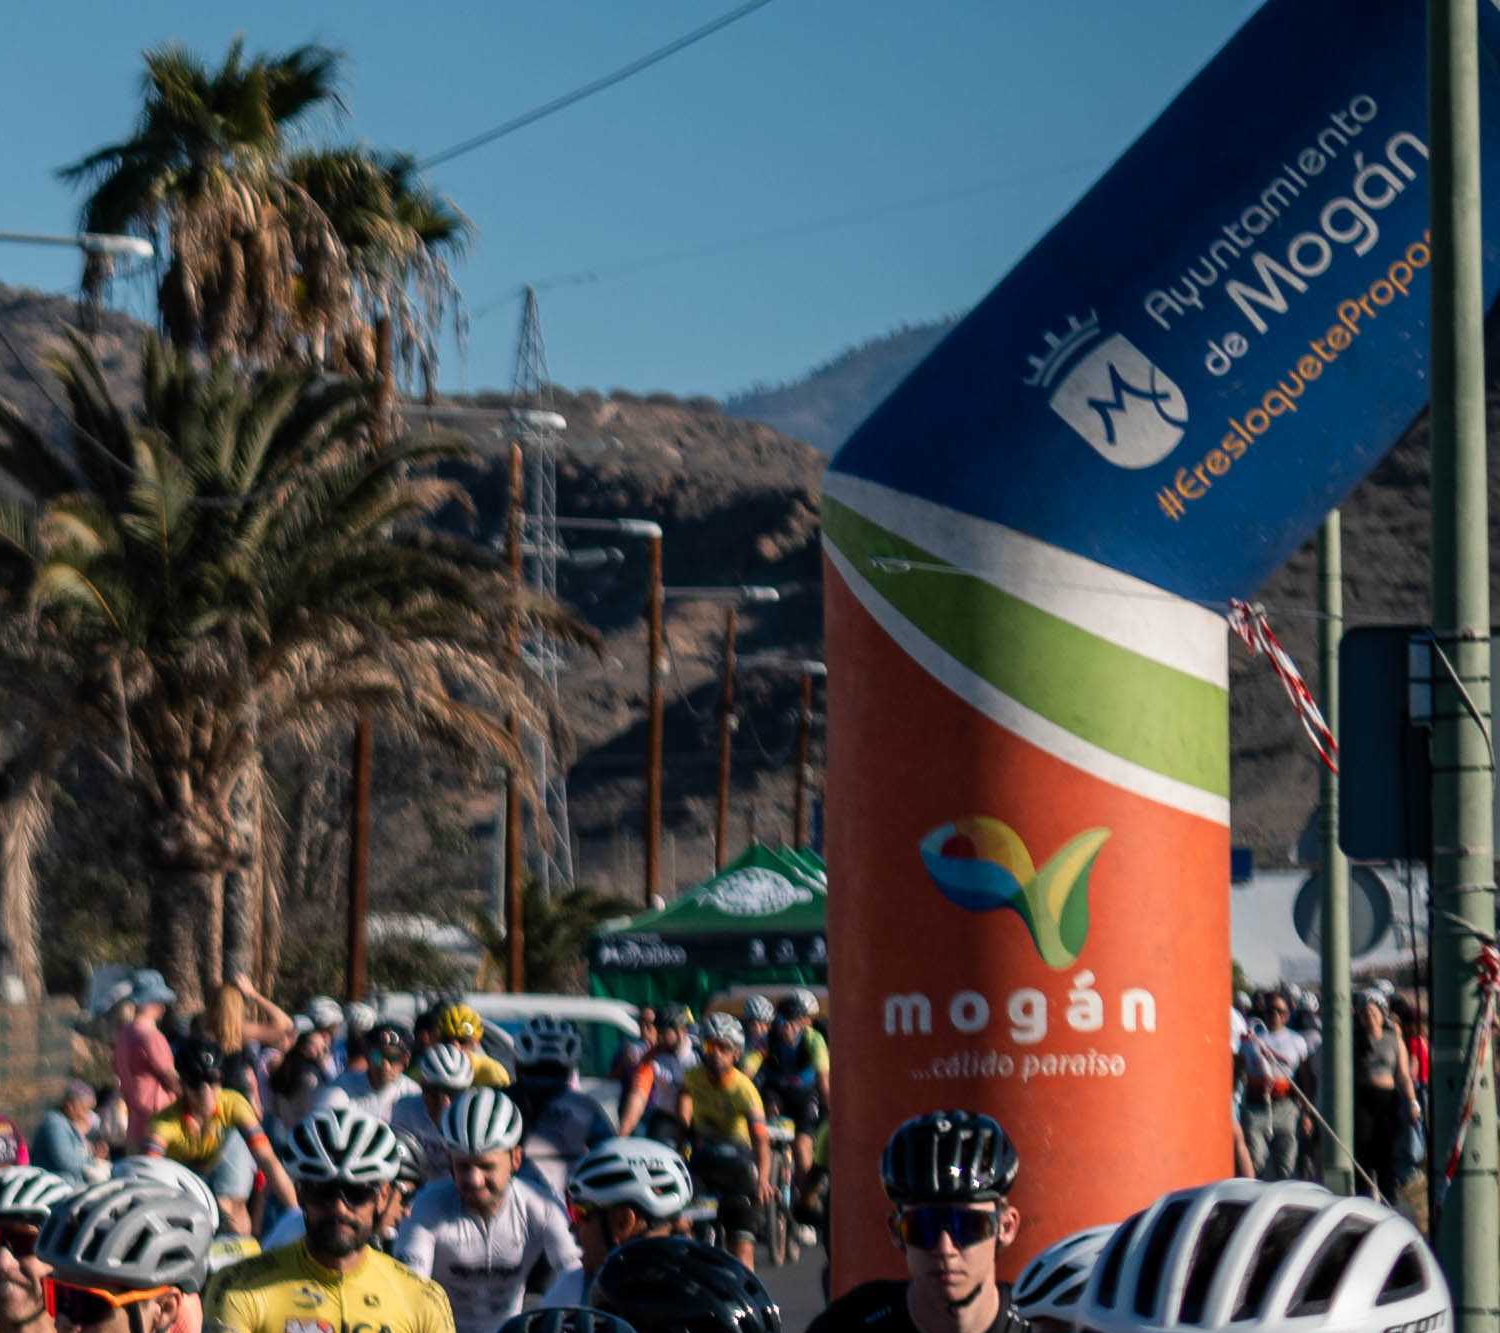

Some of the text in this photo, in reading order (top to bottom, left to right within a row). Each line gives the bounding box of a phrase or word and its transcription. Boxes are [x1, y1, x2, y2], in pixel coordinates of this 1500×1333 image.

[1145, 92, 1378, 331] Ayuntamiento
[1204, 130, 1430, 378] de Mogán
[883, 969, 1157, 1045] mogán
